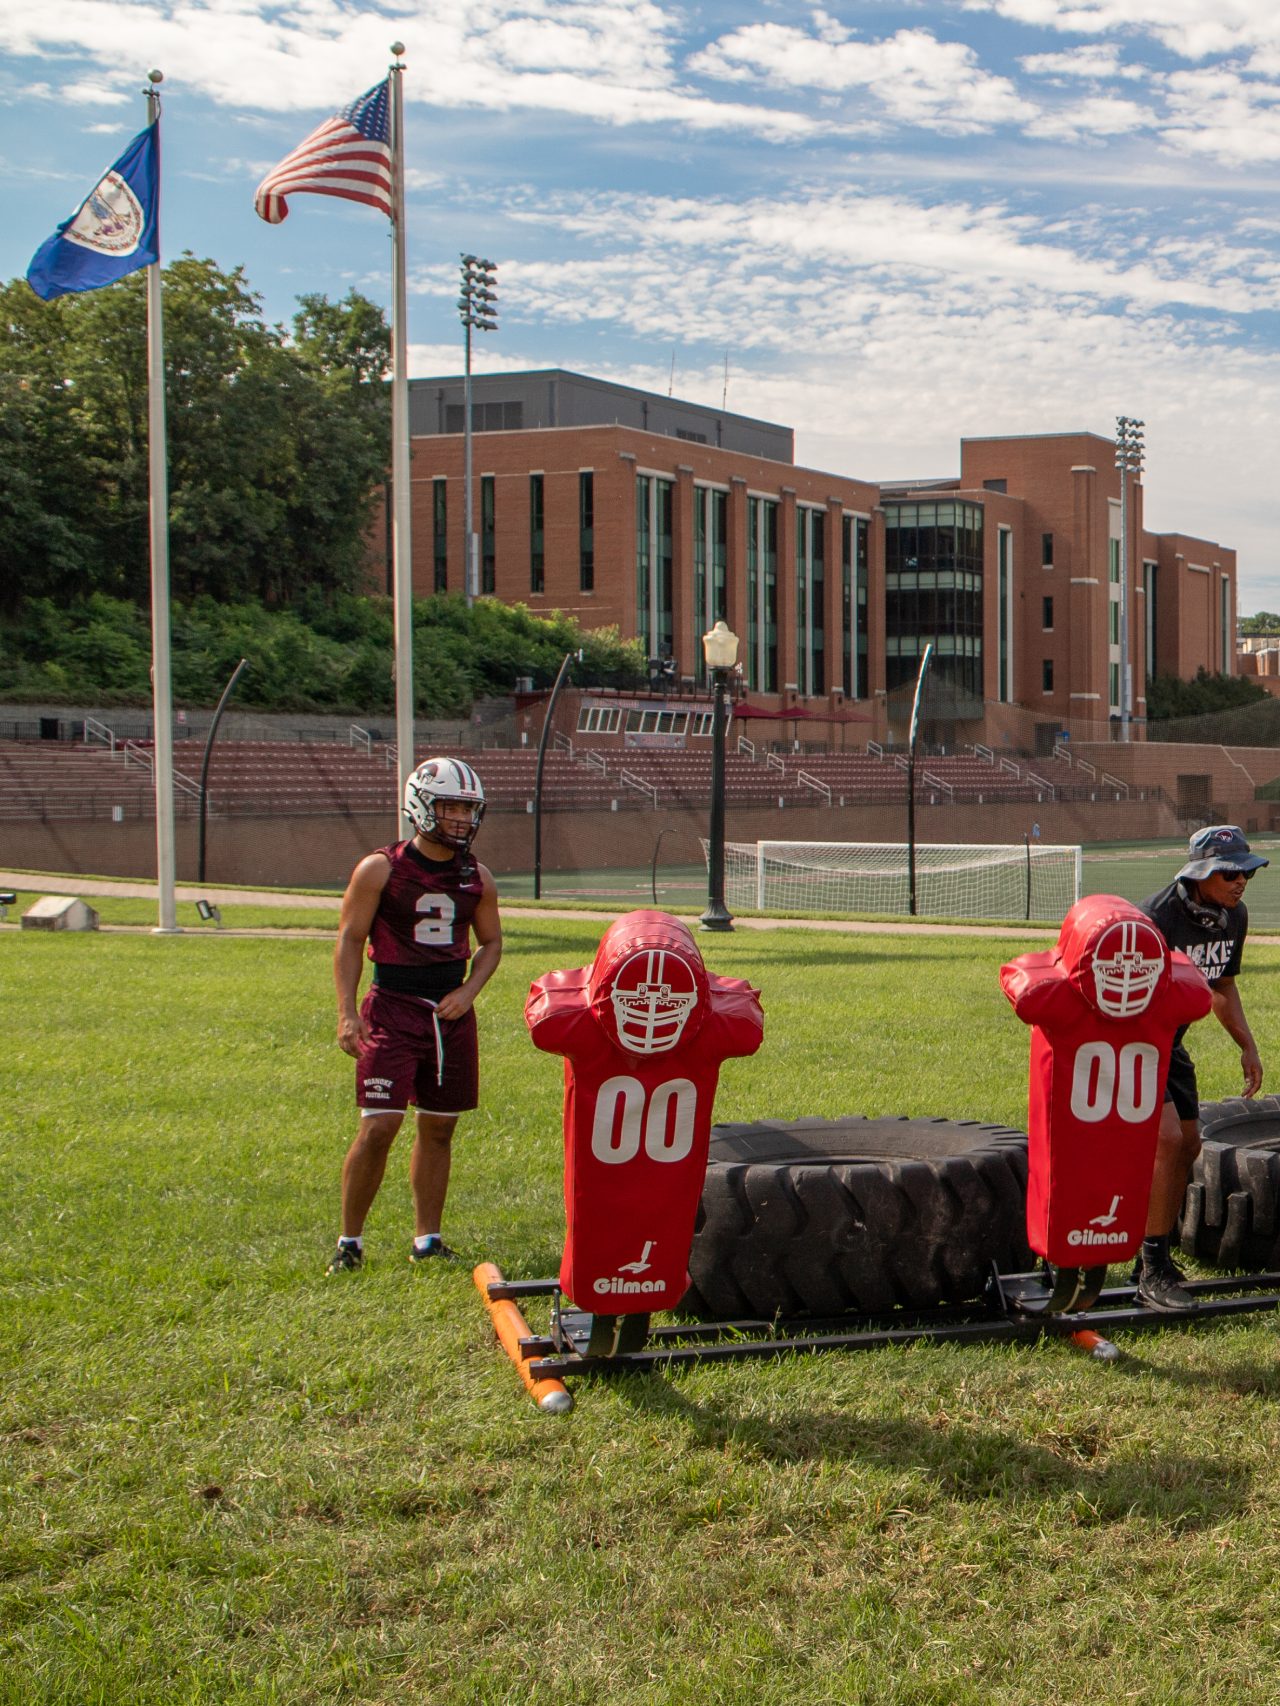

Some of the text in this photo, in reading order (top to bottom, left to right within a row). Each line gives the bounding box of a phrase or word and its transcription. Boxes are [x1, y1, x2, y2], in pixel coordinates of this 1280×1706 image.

[414, 893, 456, 945] 2
[1070, 1041, 1159, 1124] 00
[591, 1075, 697, 1165] 00
[1067, 1229, 1128, 1247] Gilman
[593, 1277, 666, 1295] Gilman
